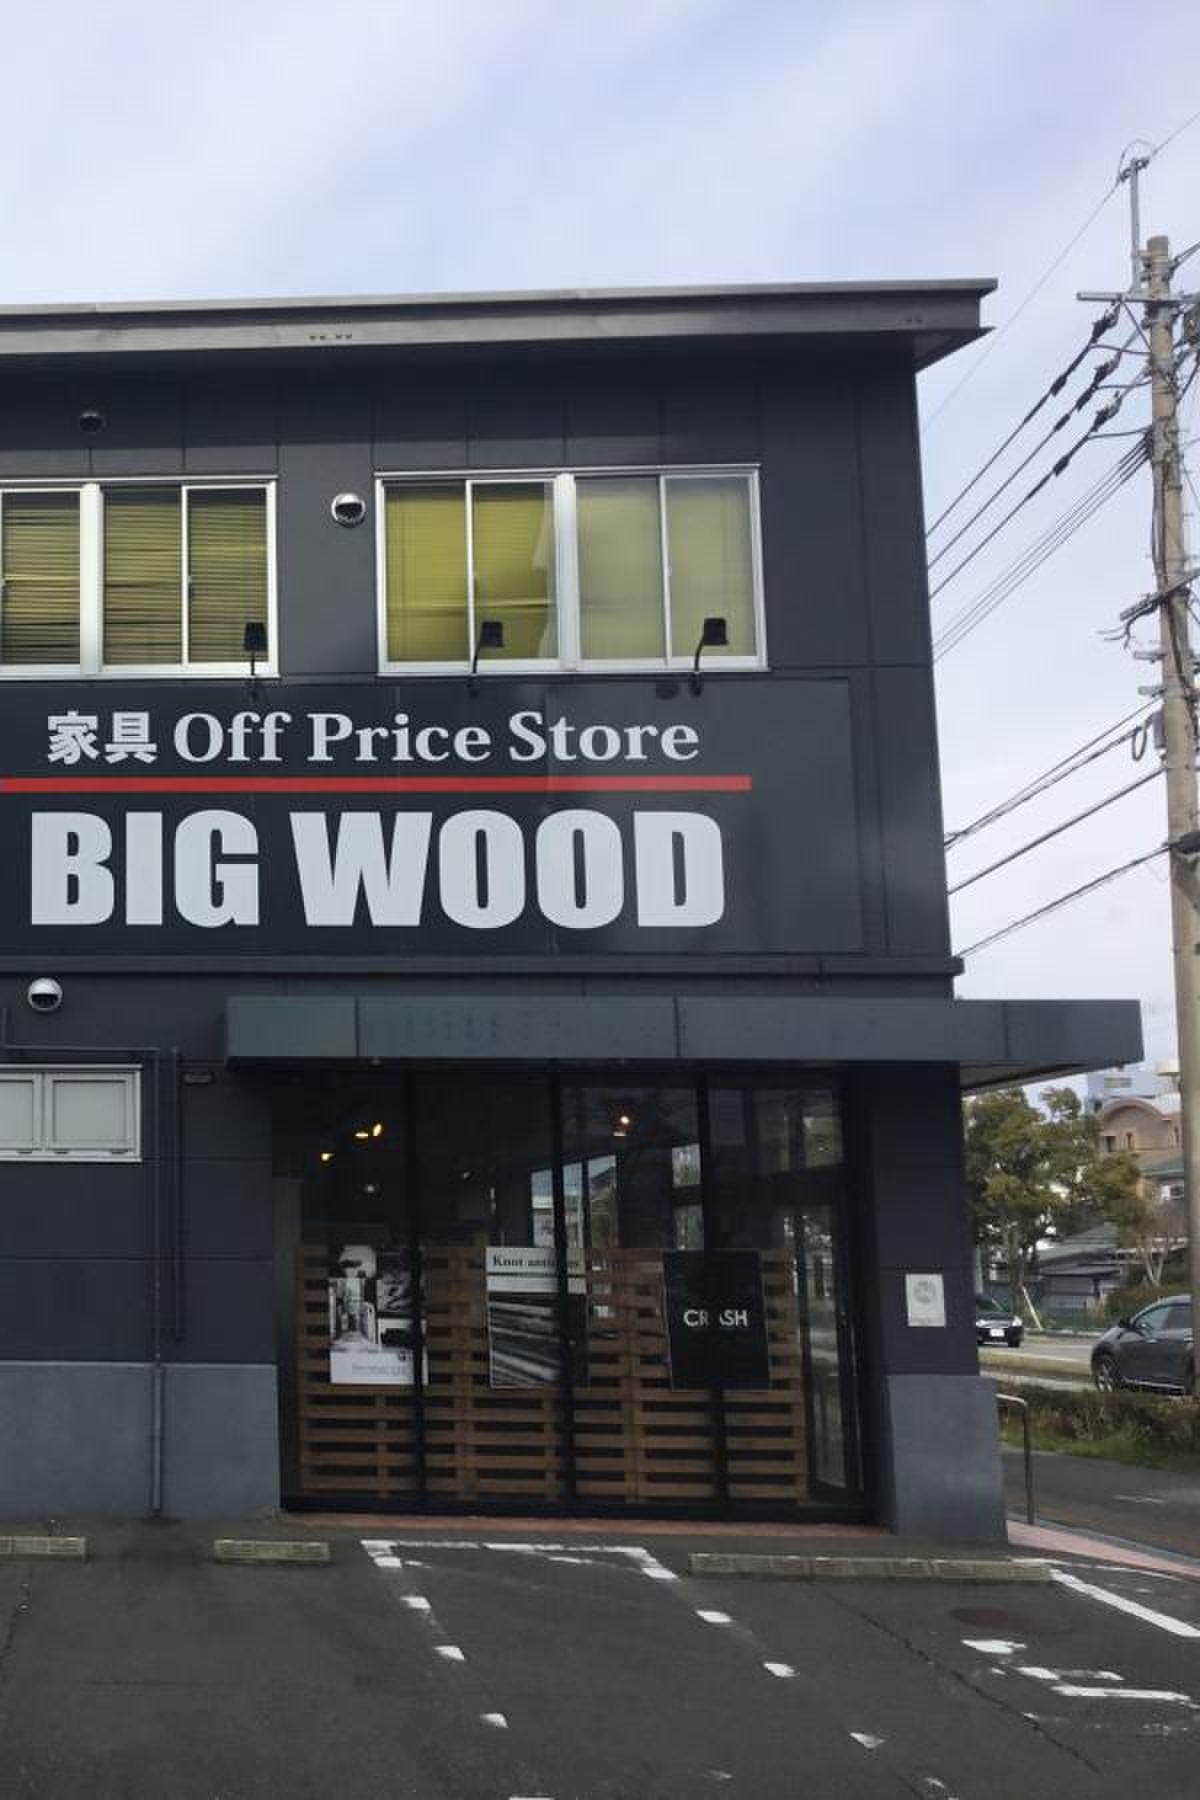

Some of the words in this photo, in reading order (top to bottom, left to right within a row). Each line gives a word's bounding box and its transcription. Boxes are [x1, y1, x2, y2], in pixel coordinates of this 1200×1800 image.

[47, 711, 158, 765] 家具
[173, 711, 292, 763] Off
[306, 712, 492, 762] Price
[508, 711, 700, 762] Store
[31, 809, 260, 928] BIG
[289, 808, 725, 929] WOOD
